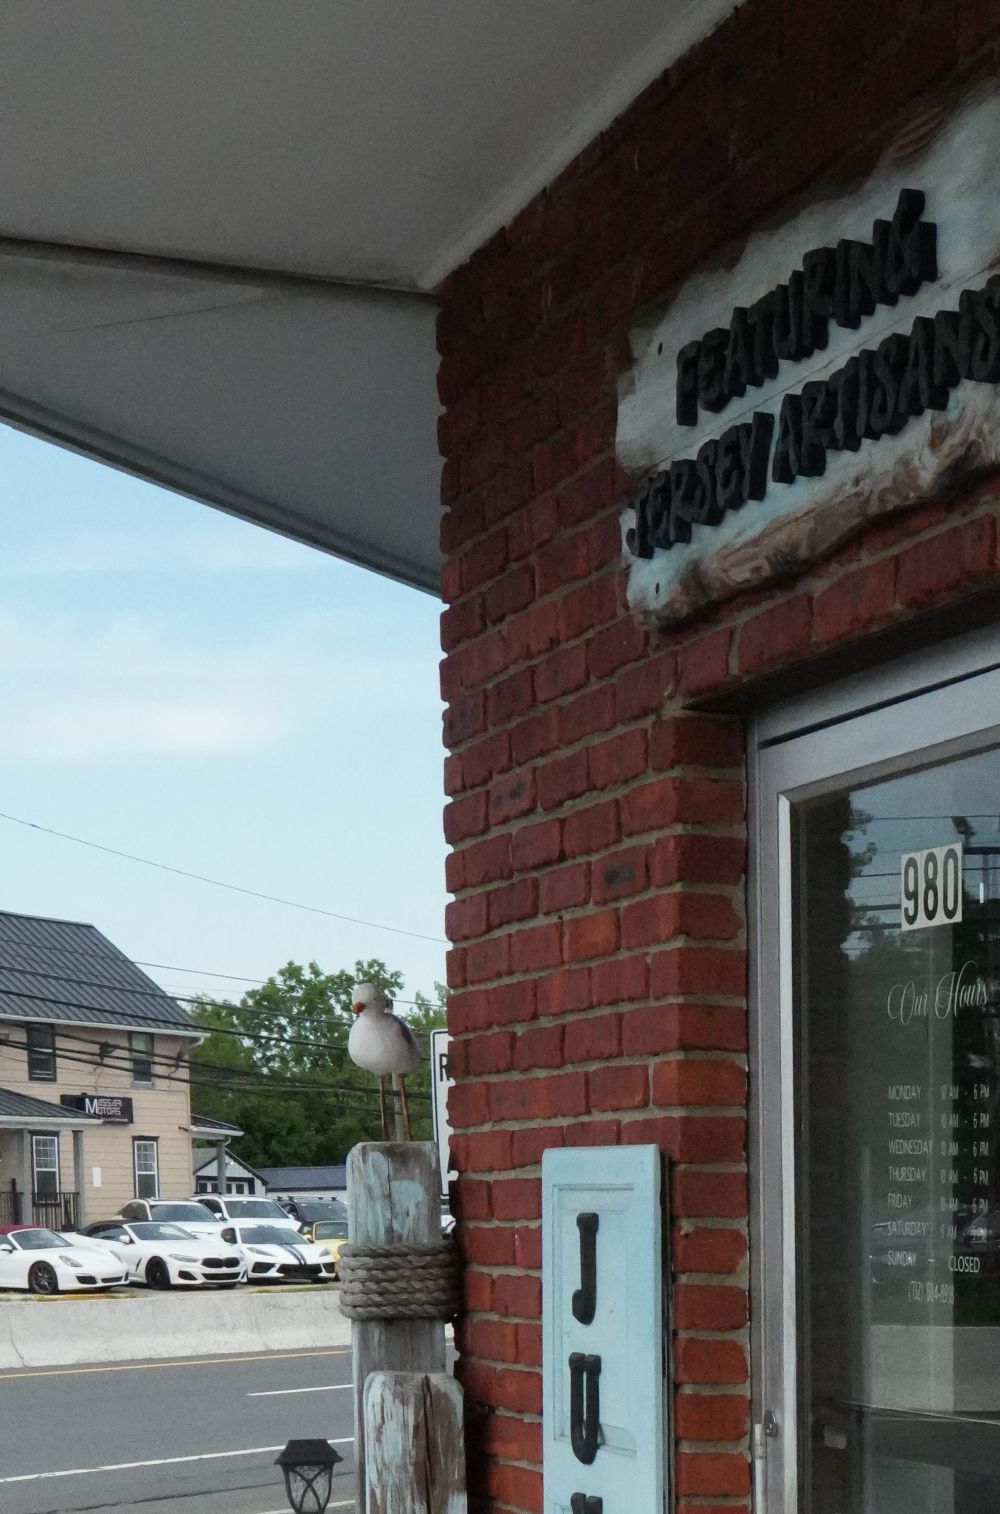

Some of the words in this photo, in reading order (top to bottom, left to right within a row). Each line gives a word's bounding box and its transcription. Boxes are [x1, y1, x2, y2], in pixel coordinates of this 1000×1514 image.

[676, 188, 938, 426] FEATURING
[626, 411, 774, 559] JERSEY
[904, 848, 959, 926] 980
[888, 981, 928, 1025] Our
[934, 961, 987, 1020] Hours
[888, 1085, 921, 1100] MONDAY
[980, 1084, 990, 1098] PM
[888, 1112, 921, 1128] TUESDAY
[980, 1113, 990, 1128] PM
[888, 1139, 933, 1155] WEDNESDAY
[980, 1141, 989, 1156] PM
[888, 1166, 927, 1182] THURSDAY
[980, 1169, 989, 1186] PM
[887, 1193, 913, 1209] FRIDAY
[980, 1198, 989, 1214] PM
[887, 1250, 917, 1267] SUNDAY
[948, 1255, 981, 1273] CLOSED
